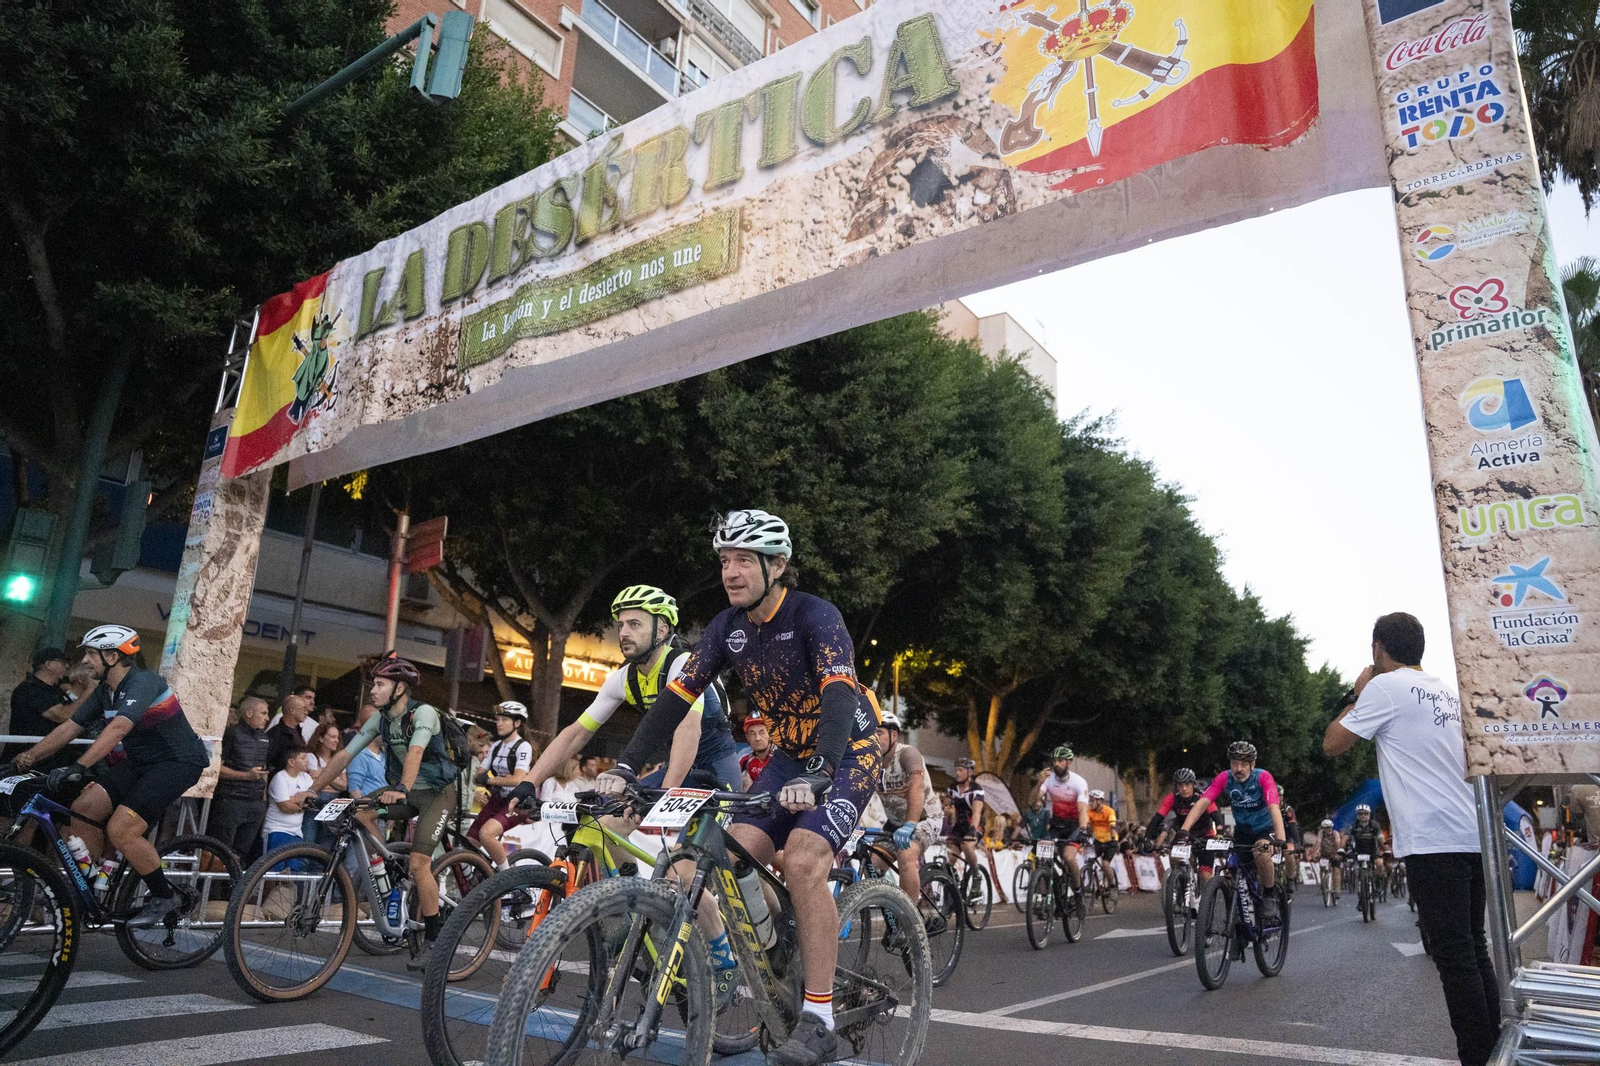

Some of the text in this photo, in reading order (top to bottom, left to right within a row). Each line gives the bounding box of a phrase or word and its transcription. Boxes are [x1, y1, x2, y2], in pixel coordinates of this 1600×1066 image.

[1385, 11, 1491, 71] Coca-Cola
[1397, 64, 1493, 103] GRUPO
[1398, 79, 1501, 125] RENTA
[1401, 102, 1504, 148] TODO
[355, 11, 961, 342] LA DESÉRTICA
[1406, 152, 1523, 191] TORRECARDENAS
[1460, 210, 1526, 233] Andalucía
[481, 243, 702, 342] La Legión y el desierto nos une
[1431, 309, 1547, 350] primaflor
[1470, 434, 1543, 456] Almería
[1477, 451, 1541, 470] Activa
[1492, 611, 1580, 630] Fundación
[1411, 686, 1443, 708] Pepe
[660, 798, 703, 812] 5045
[56, 838, 88, 891] cannondale
[62, 907, 73, 962] MAXXIS
